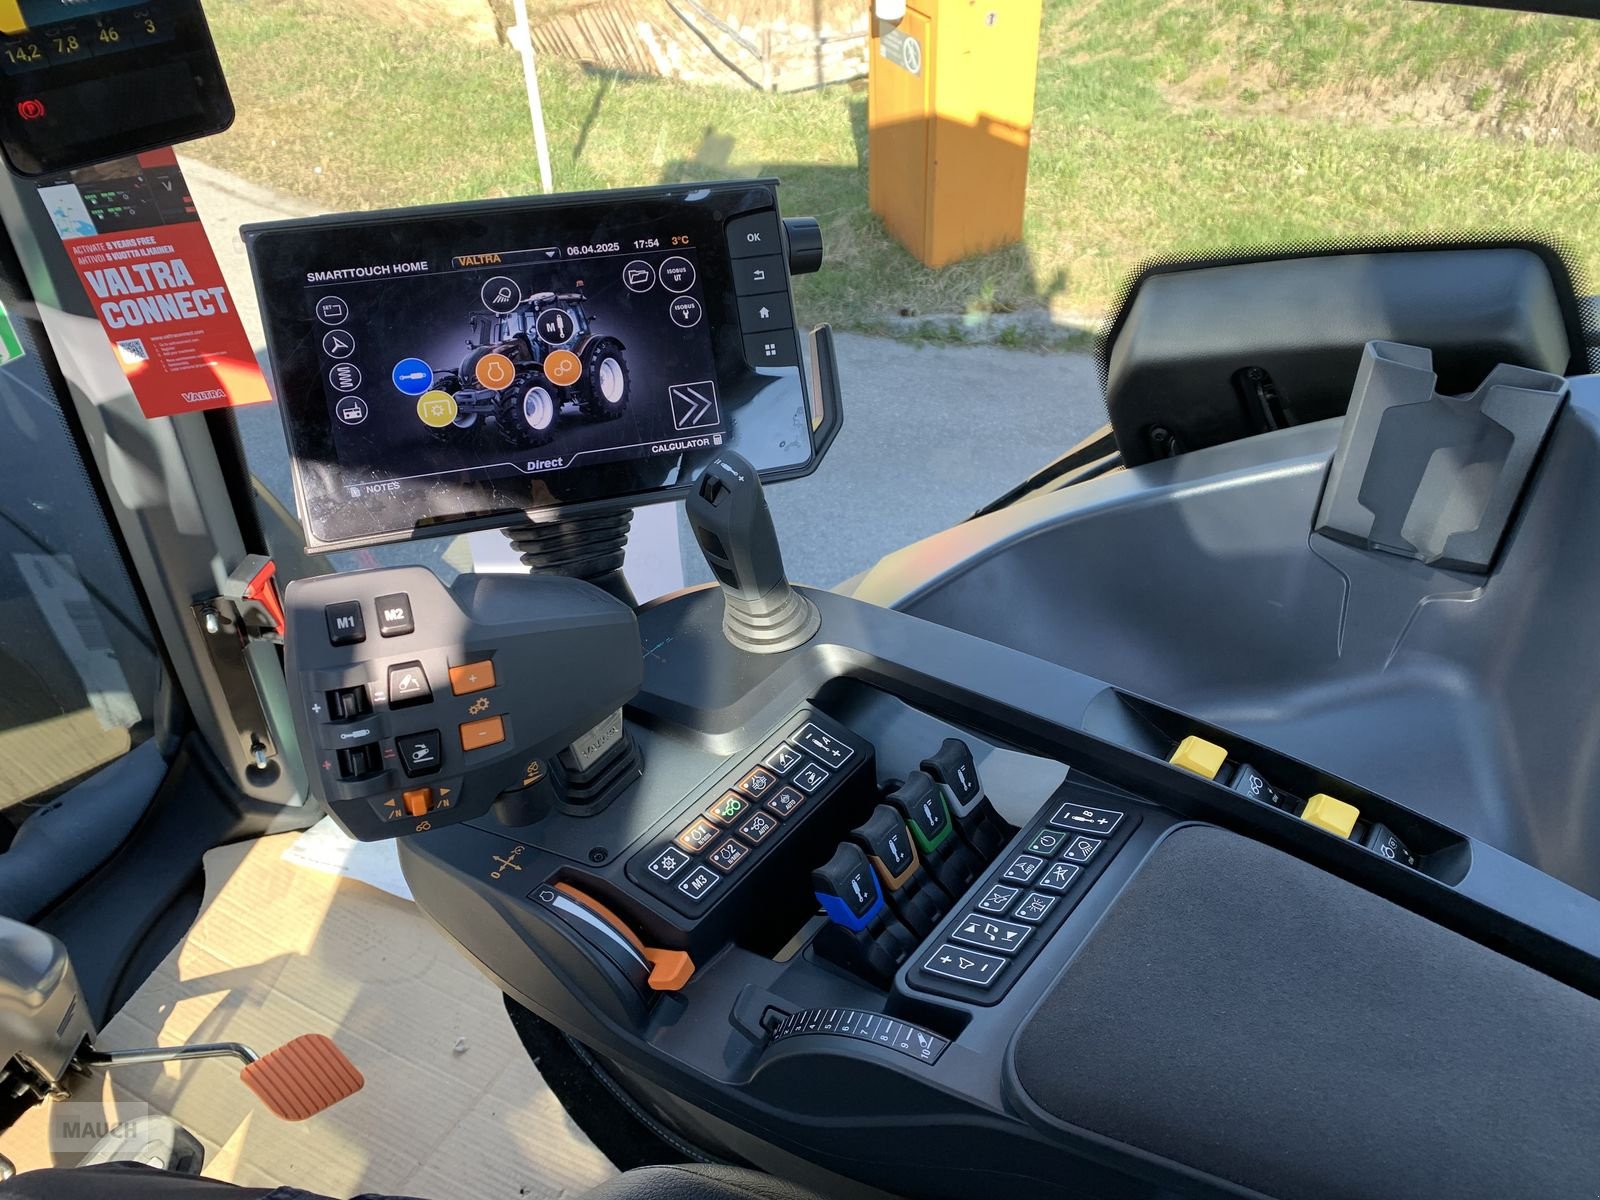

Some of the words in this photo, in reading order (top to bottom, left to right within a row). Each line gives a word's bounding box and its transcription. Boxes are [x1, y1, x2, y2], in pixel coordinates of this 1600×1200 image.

[5, 44, 41, 64] 14,2
[53, 35, 79, 53] 7,8
[100, 27, 119, 43] 46
[143, 19, 156, 33] 3
[136, 236, 156, 245] FREE
[746, 232, 761, 242] OK
[567, 242, 620, 256] 06.04.2025
[633, 238, 660, 249] 17:54
[671, 235, 690, 246] 3°C
[458, 254, 501, 266] VALTRA
[84, 258, 194, 298] VALTRA
[306, 264, 390, 282] SMARTTOUCH
[392, 261, 429, 273] HOME
[674, 274, 682, 282] UT
[100, 286, 228, 329] CONNECT
[181, 388, 226, 403] VALTRA
[651, 437, 710, 453] CALCULATOR
[527, 457, 563, 471] Direct
[366, 481, 400, 493] NOTES
[384, 608, 404, 621] M2
[337, 616, 355, 630] M1
[822, 736, 831, 745] A
[758, 824, 770, 836] AUTO
[691, 874, 708, 891] M3
[920, 1049, 931, 1059] 10
